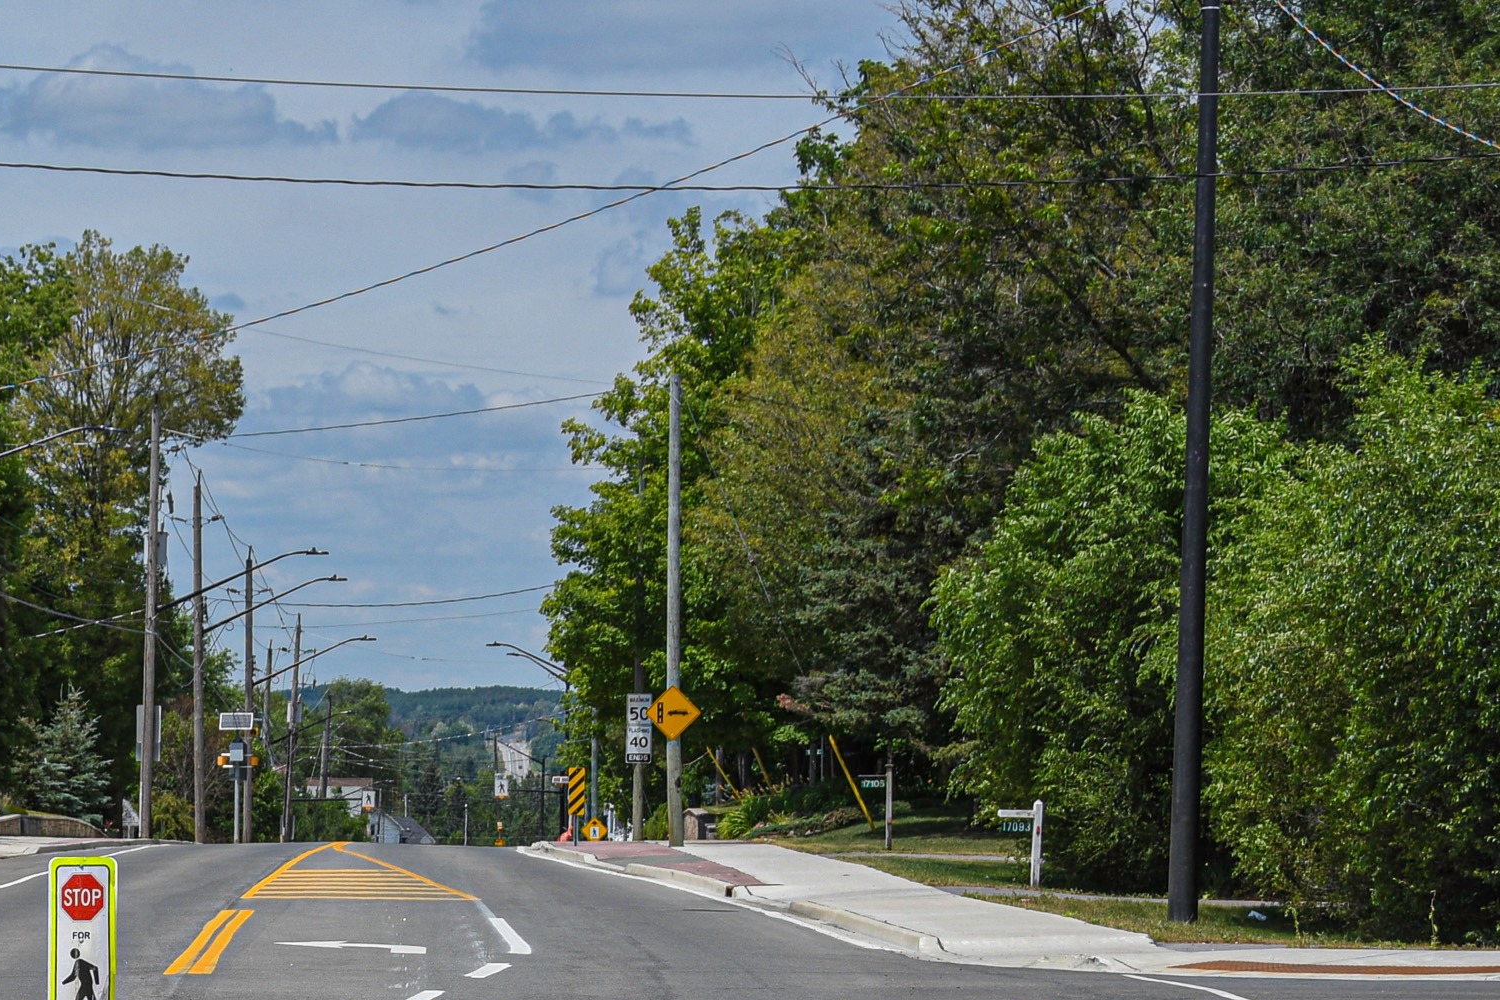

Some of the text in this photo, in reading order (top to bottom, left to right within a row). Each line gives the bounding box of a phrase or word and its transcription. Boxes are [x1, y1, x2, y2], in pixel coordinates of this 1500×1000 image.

[630, 707, 649, 720] 50
[630, 737, 648, 748] 40
[1002, 822, 1031, 832] 17093
[63, 888, 102, 907] STOP
[72, 931, 91, 940] FOR
